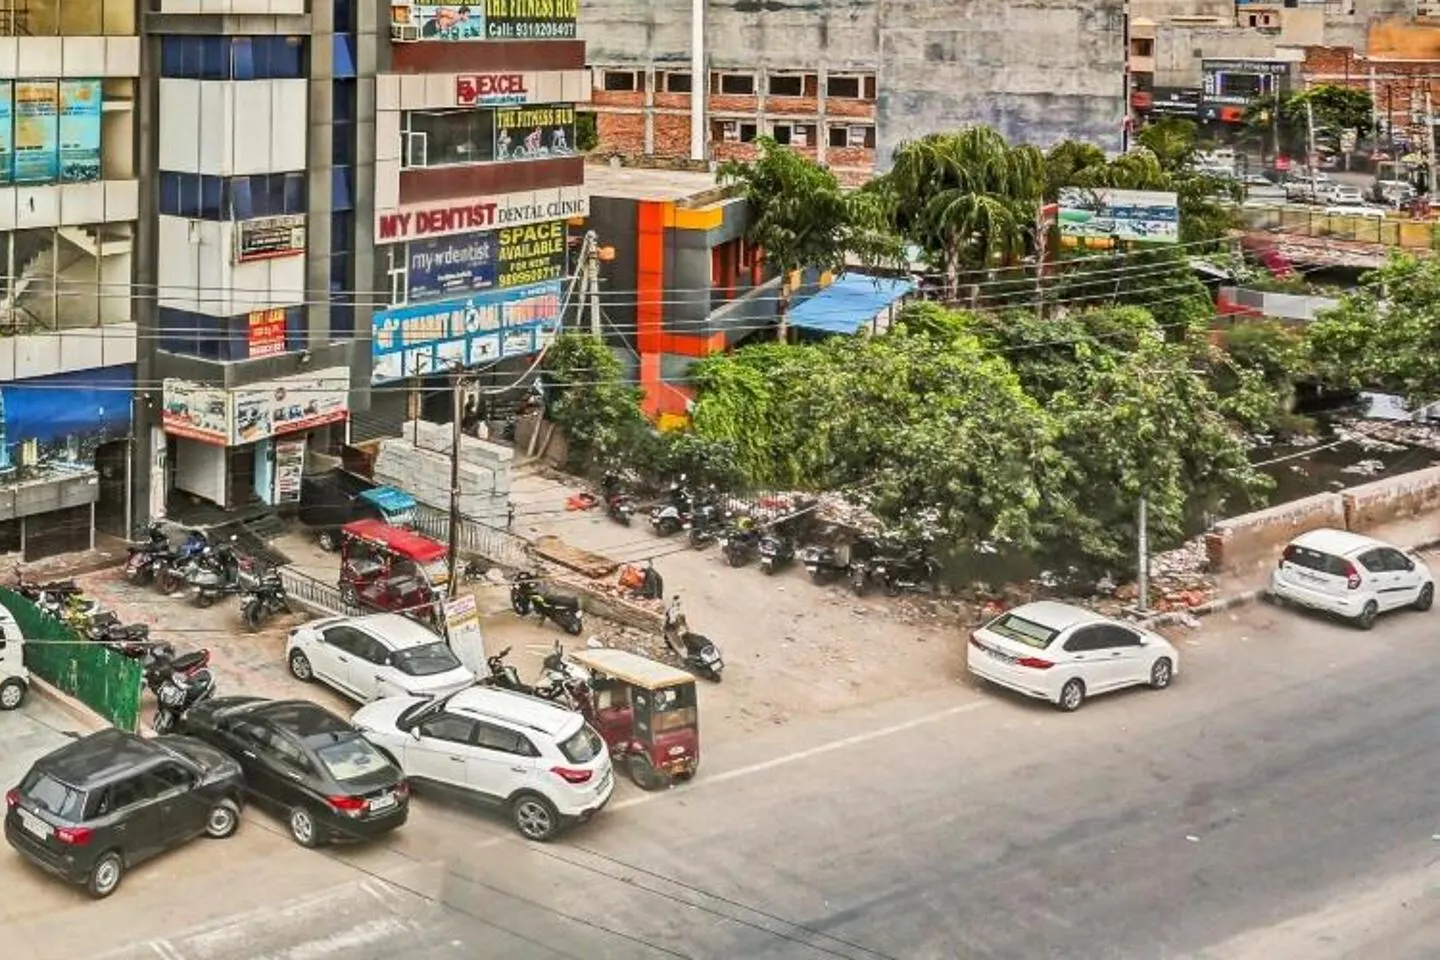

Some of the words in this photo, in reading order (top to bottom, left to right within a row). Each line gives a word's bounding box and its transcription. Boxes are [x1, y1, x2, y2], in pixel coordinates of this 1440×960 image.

[477, 74, 528, 94] EXCEL
[379, 213, 411, 239] MY
[416, 203, 497, 233] DENTIST
[499, 205, 544, 223] DENTAL
[546, 200, 586, 218] CLINIC
[498, 222, 562, 245] SPACE
[499, 238, 563, 261] AVAILABLE
